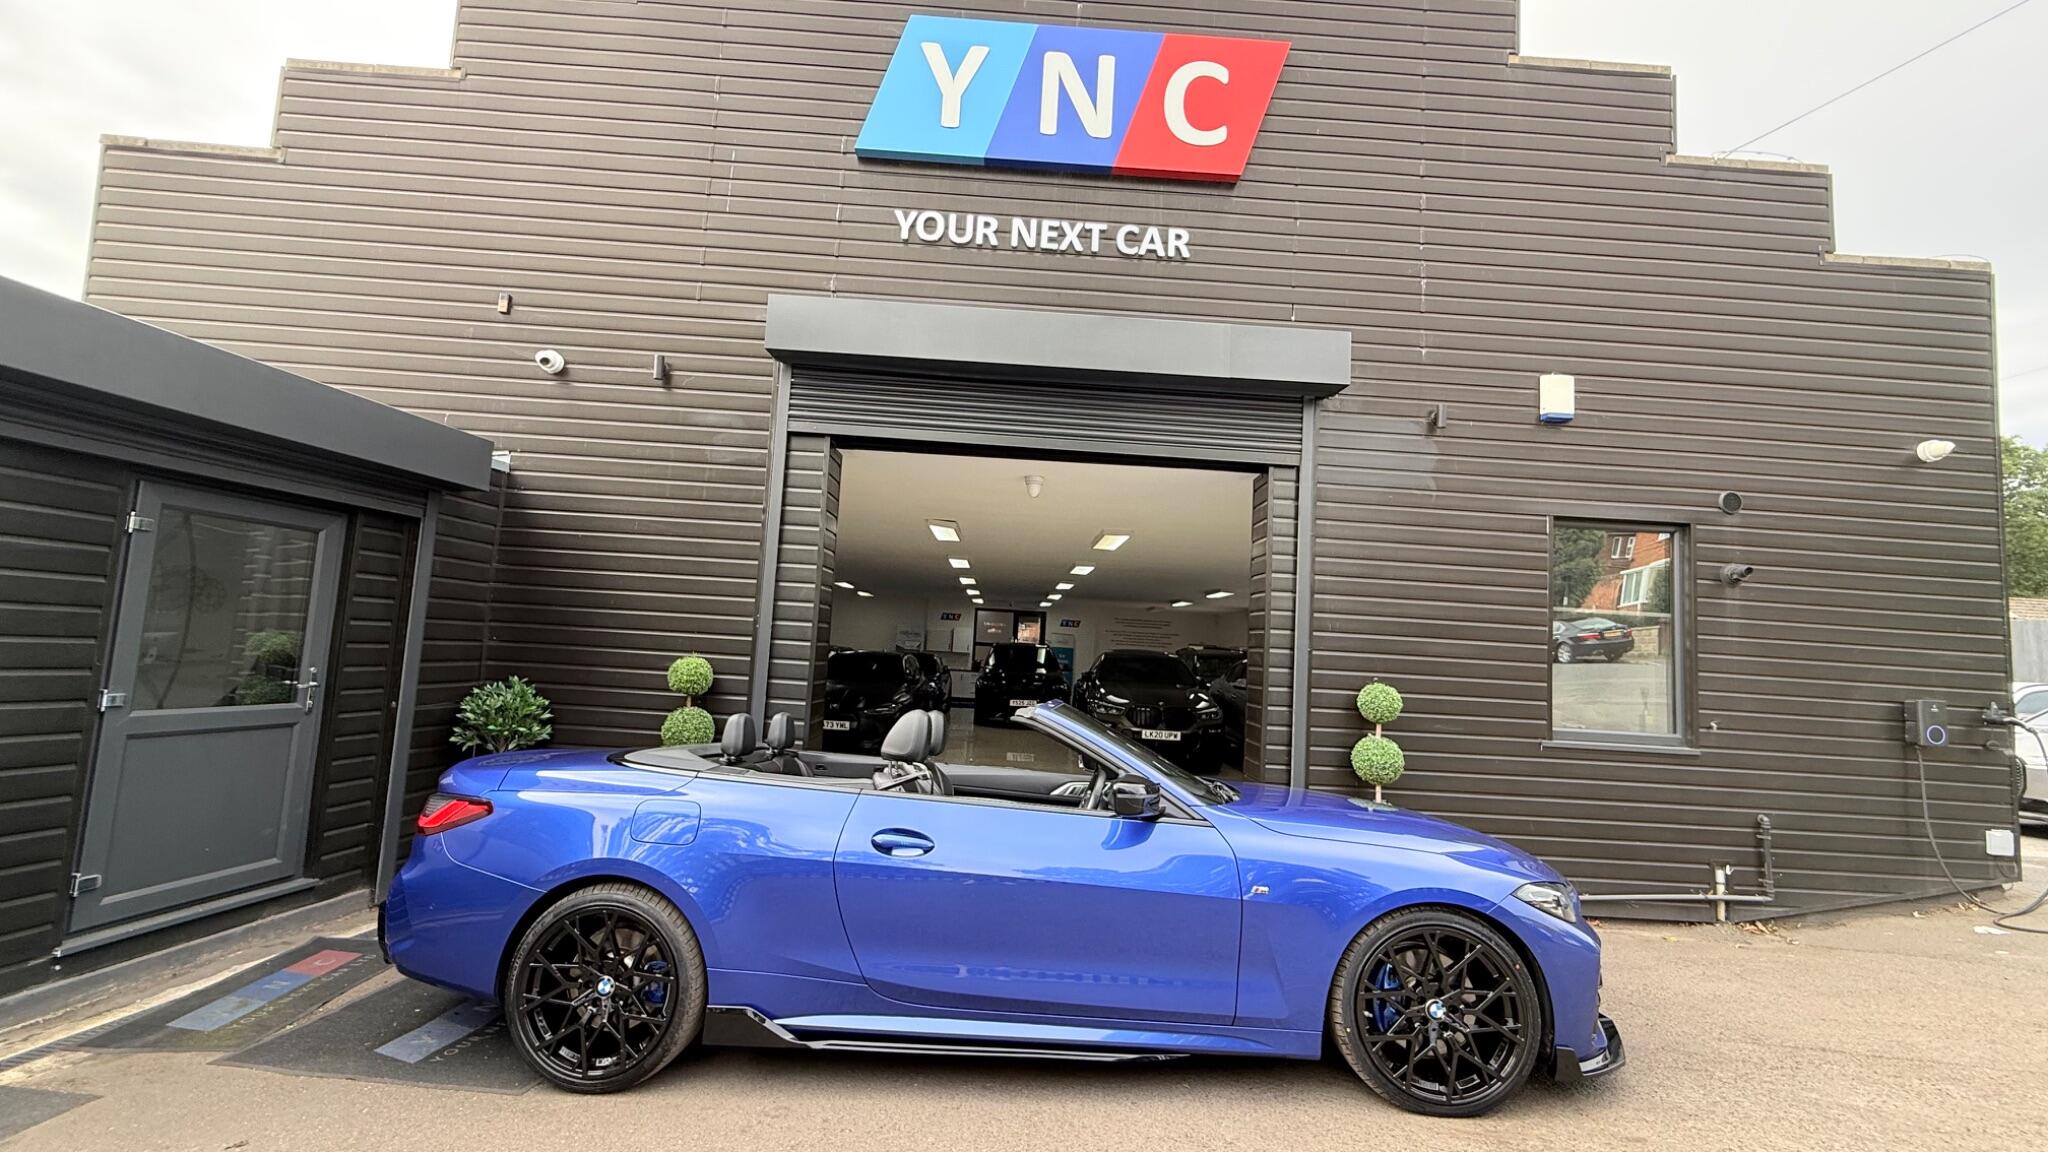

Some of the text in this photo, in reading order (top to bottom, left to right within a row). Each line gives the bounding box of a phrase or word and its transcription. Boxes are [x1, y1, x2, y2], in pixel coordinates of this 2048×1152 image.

[920, 42, 1230, 146] YNC
[894, 209, 1191, 258] YOUR NEXT CAR
[1144, 731, 1163, 739] LK20
